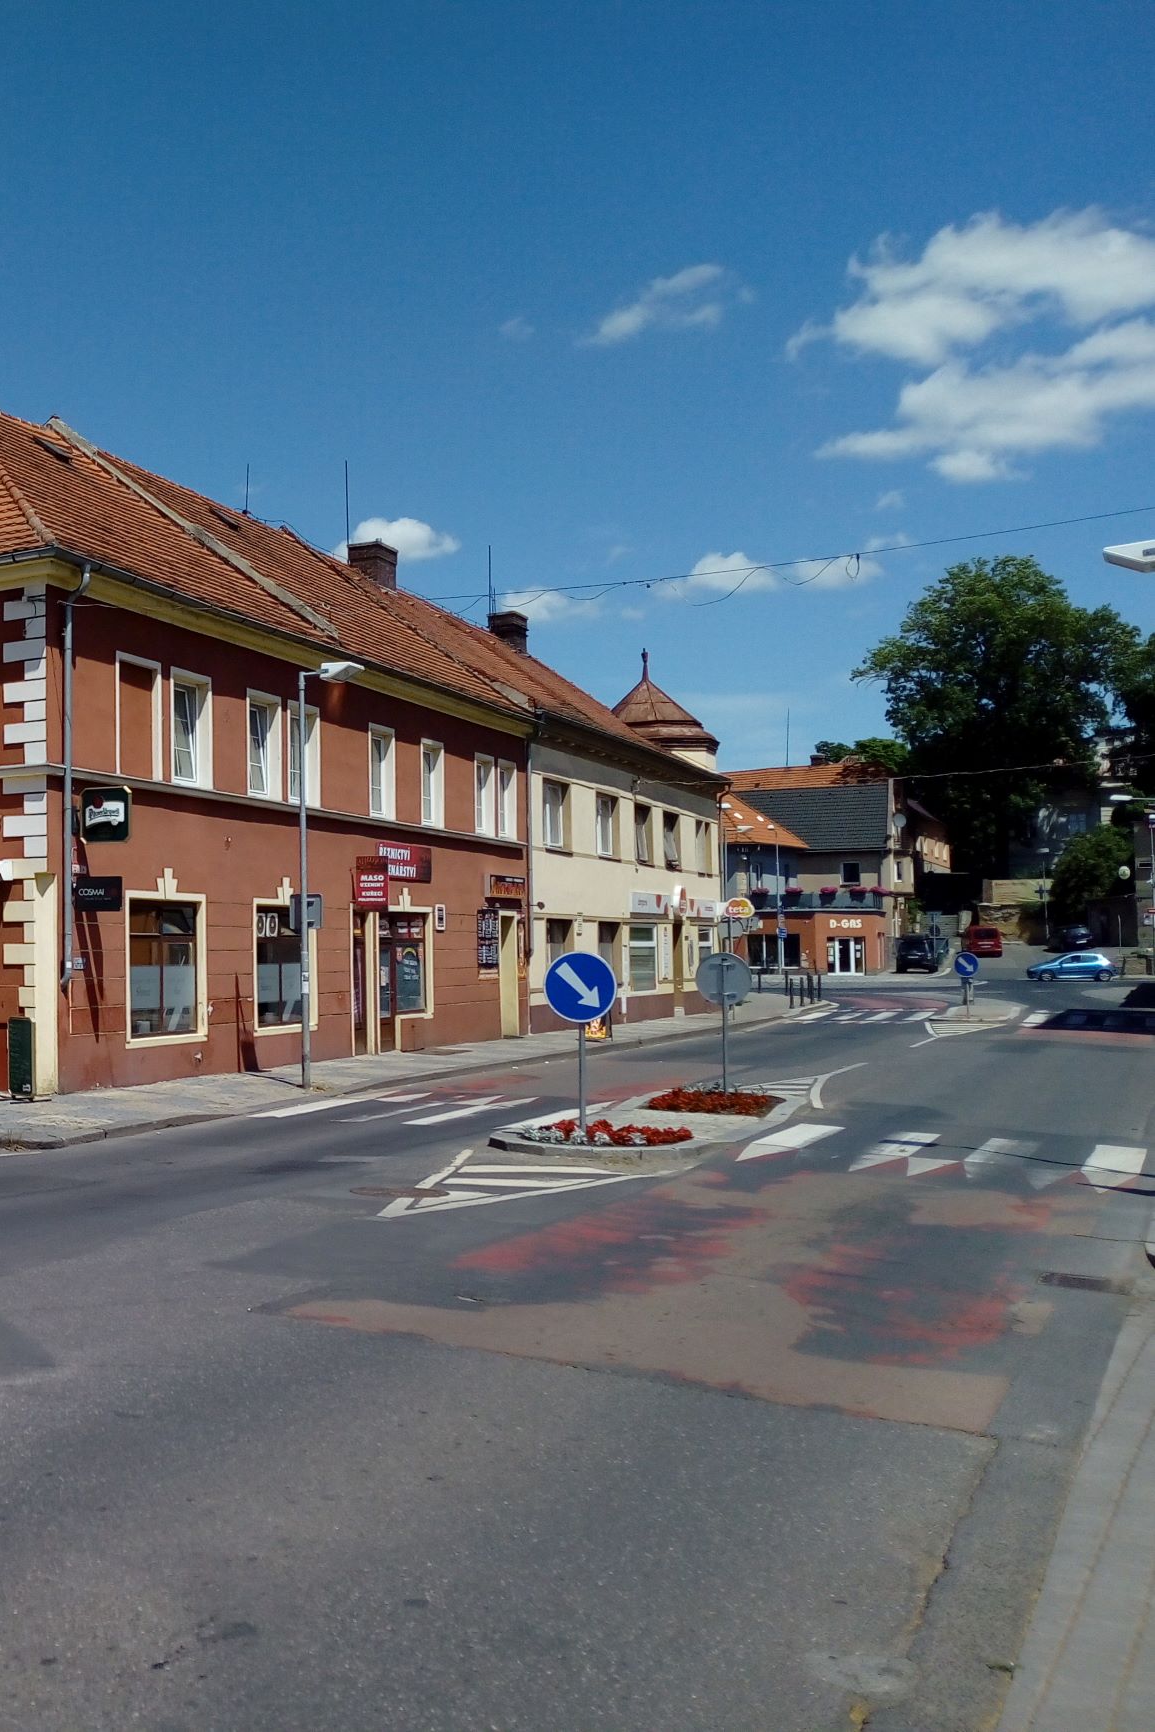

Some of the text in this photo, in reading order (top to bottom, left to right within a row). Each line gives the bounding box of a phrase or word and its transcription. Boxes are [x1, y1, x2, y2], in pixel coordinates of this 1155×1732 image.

[378, 843, 411, 861] ŘEZNICTVÍ
[388, 862, 416, 878] ENÁŘSTVÍ
[360, 874, 385, 882] MASO
[829, 919, 862, 929] D-GAS
